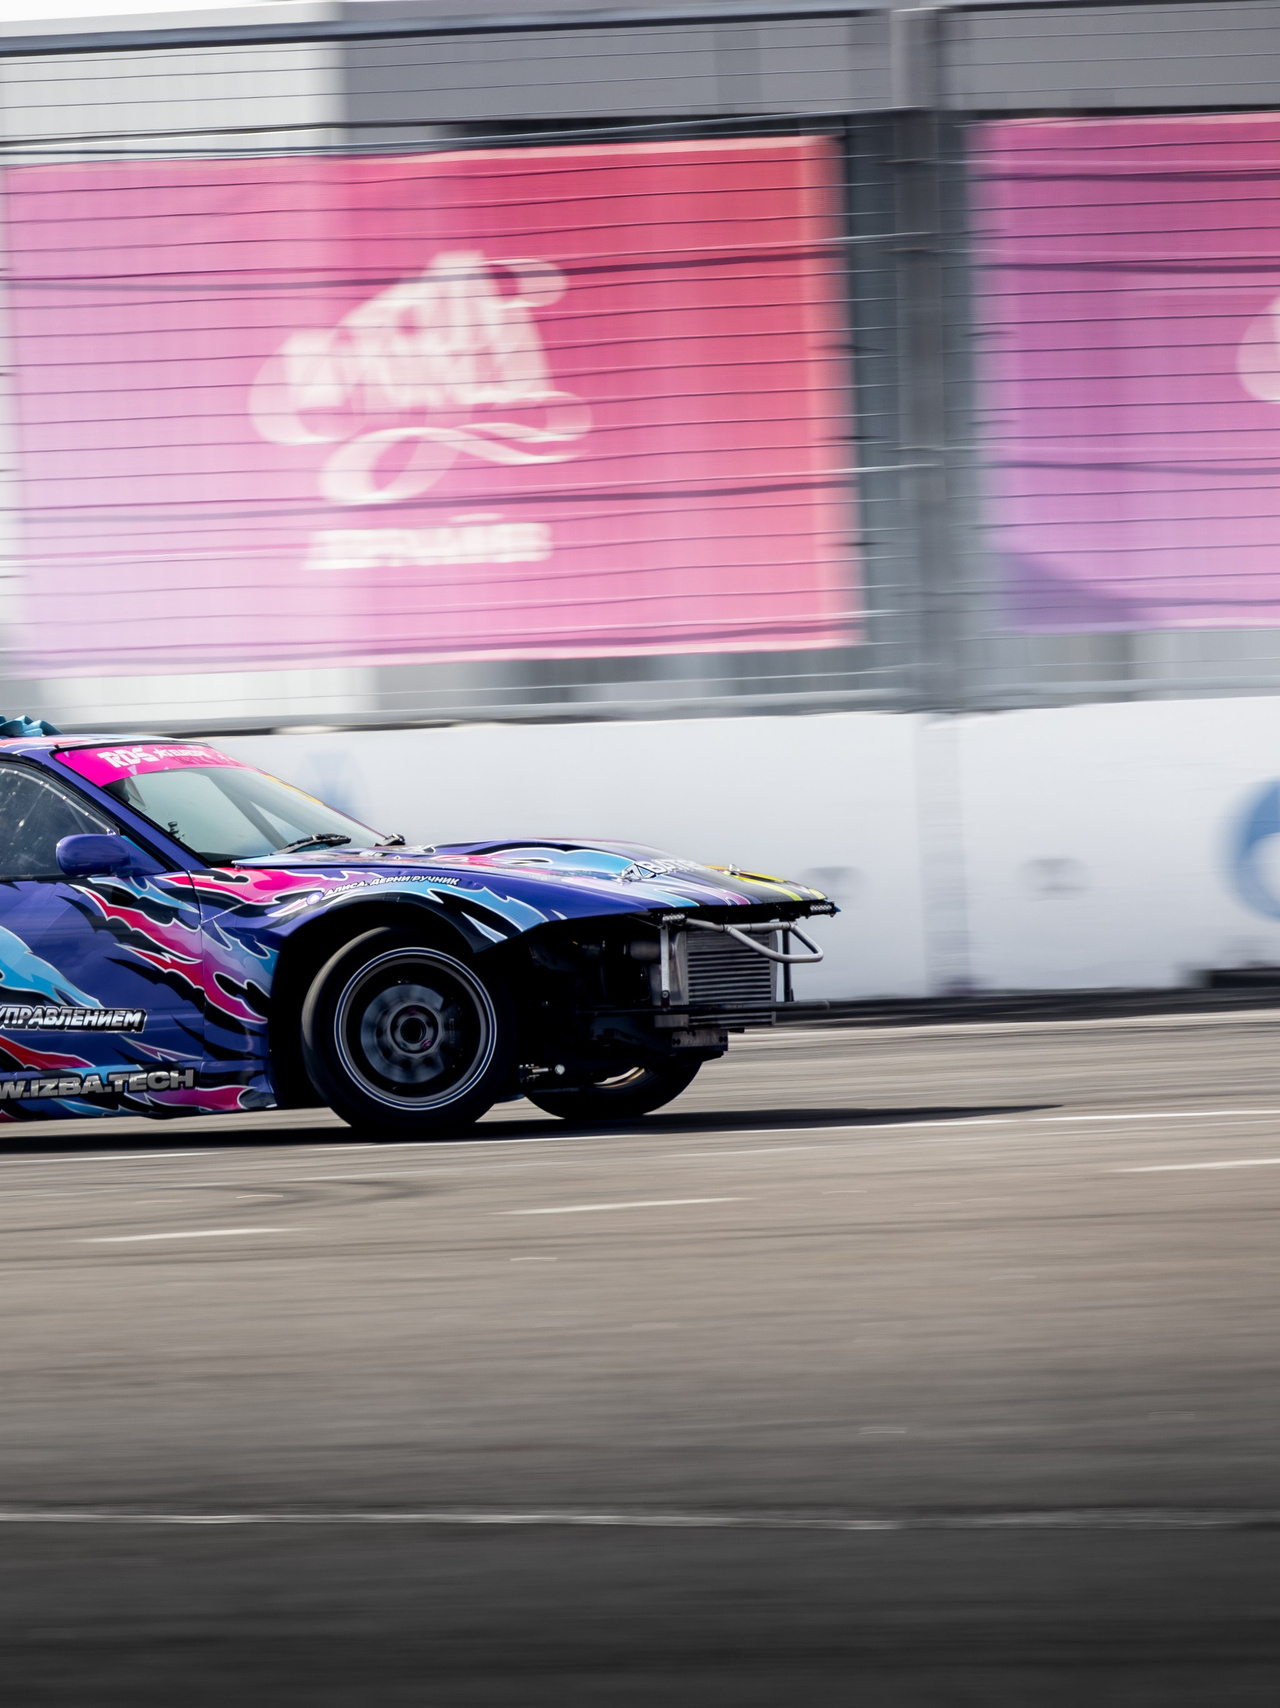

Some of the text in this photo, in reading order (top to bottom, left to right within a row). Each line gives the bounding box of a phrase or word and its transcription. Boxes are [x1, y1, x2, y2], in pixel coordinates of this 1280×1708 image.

[97, 747, 160, 768] RDS
[370, 875, 410, 886] ДЕРНИ
[412, 874, 460, 886] РУЧНИК
